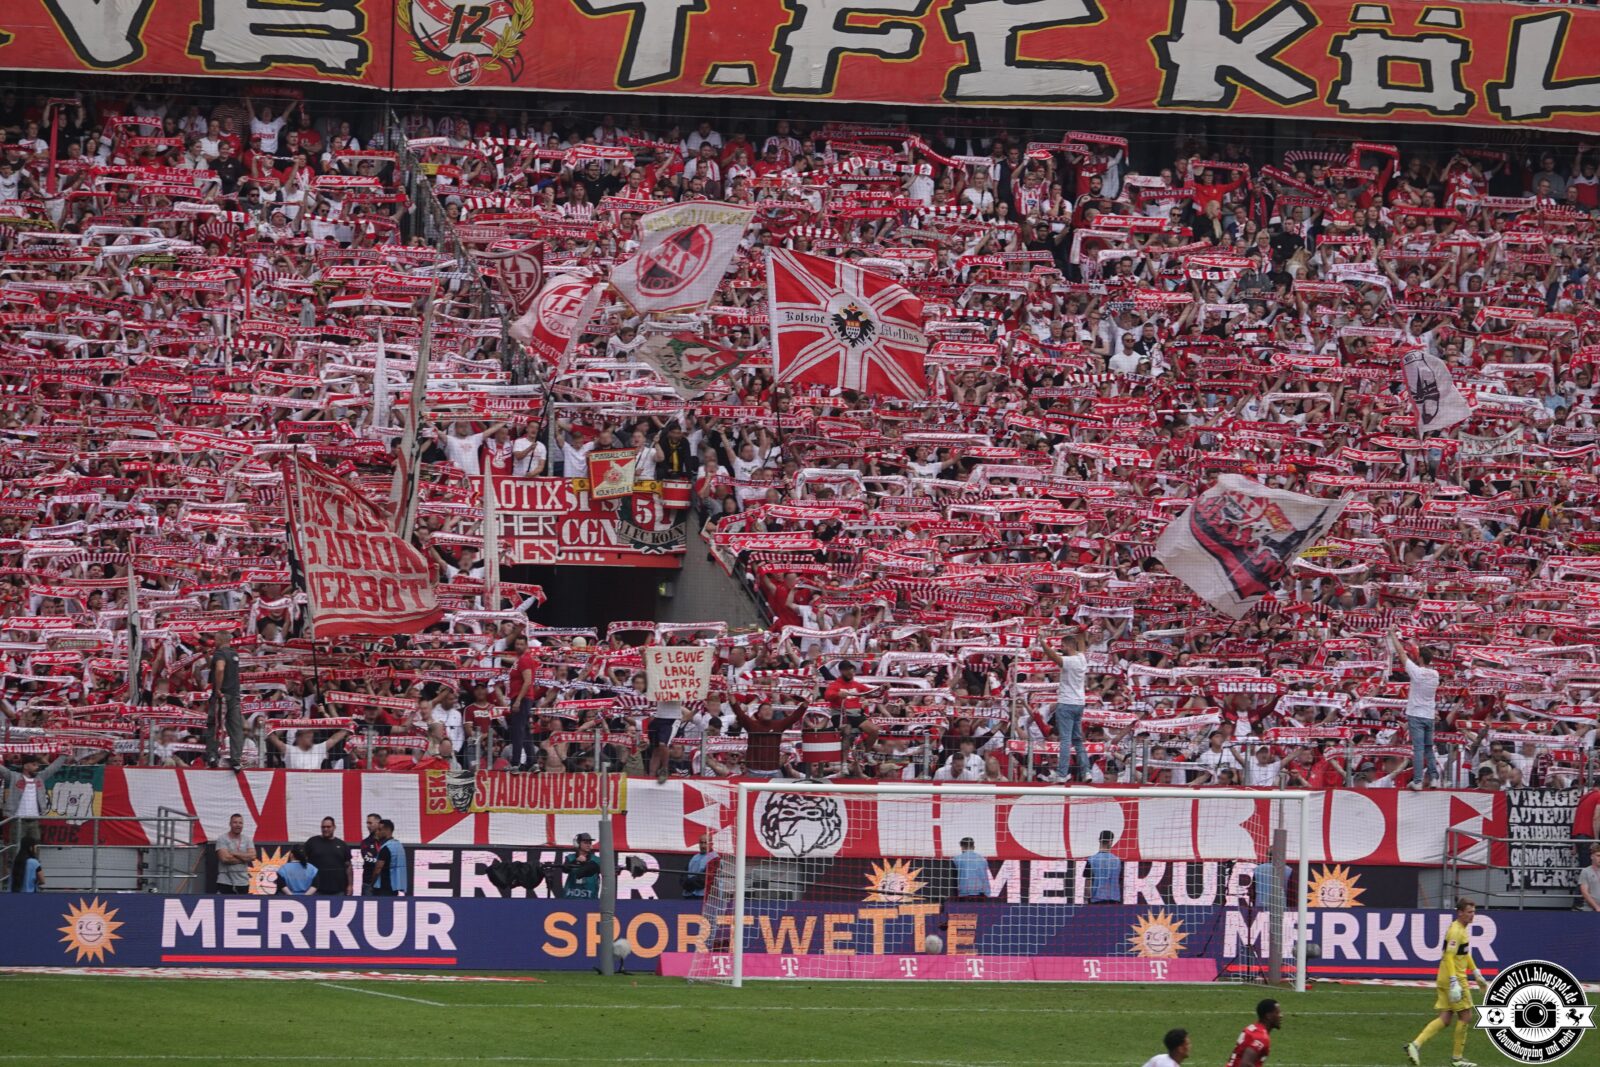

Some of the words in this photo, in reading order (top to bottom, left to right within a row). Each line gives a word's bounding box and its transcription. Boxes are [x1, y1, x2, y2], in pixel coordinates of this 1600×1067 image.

[447, 4, 491, 43] 12
[770, 0, 1111, 102] FC
[663, 666, 696, 677] LANG
[659, 678, 702, 691] ULTRAS
[1217, 682, 1277, 694] RAFIKIS
[685, 690, 700, 701] FC
[1508, 788, 1579, 807] VIRAGE
[566, 887, 592, 899] HOST
[161, 898, 457, 951] MERKUR
[1223, 910, 1499, 962] MERKUR
